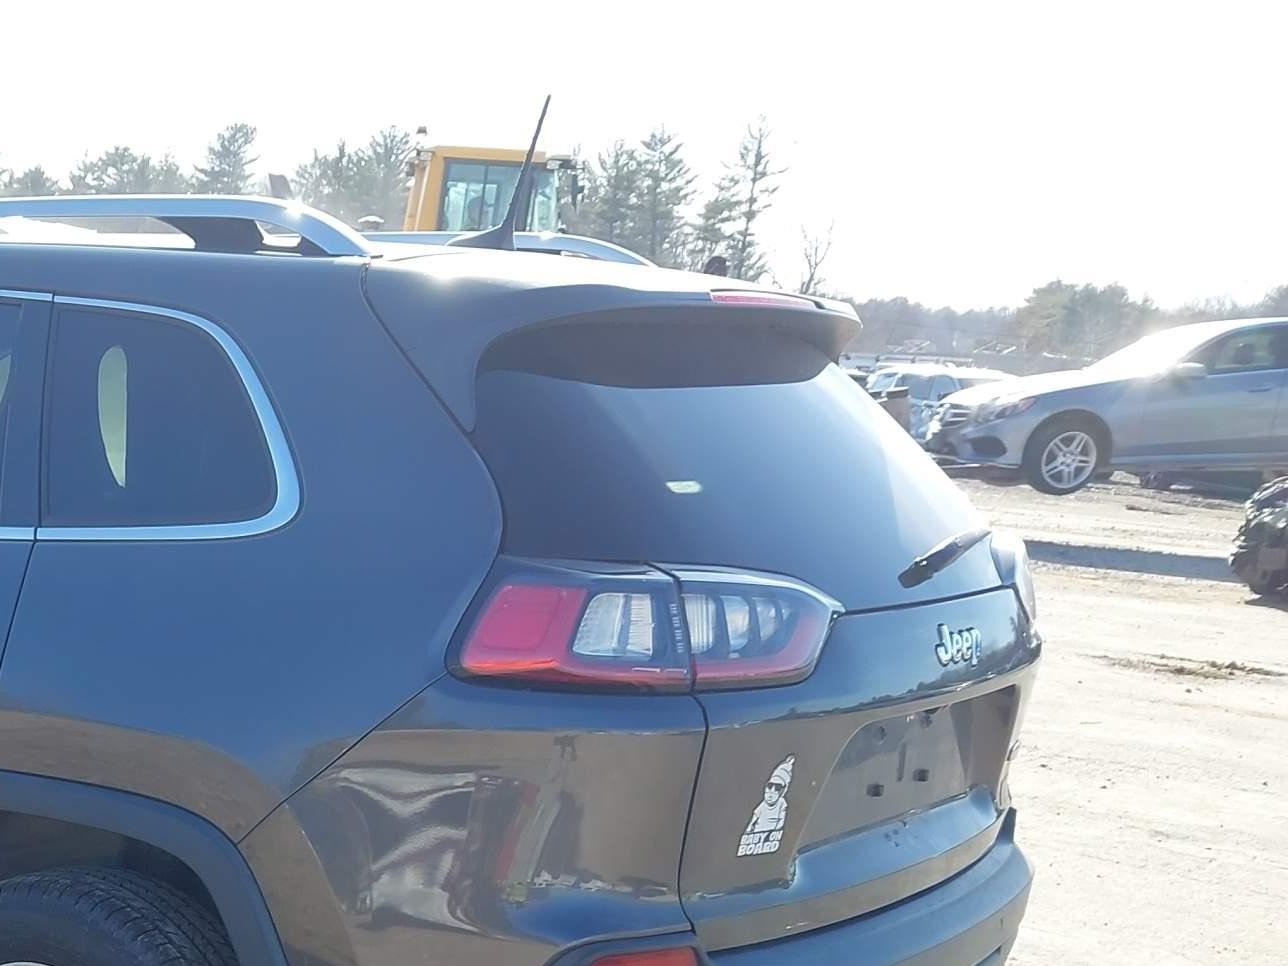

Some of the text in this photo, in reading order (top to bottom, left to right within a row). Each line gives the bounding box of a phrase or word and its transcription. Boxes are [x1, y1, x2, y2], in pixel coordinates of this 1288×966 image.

[935, 623, 981, 668] Jeep
[740, 830, 784, 845] BABY ON
[737, 841, 780, 857] BOARD
